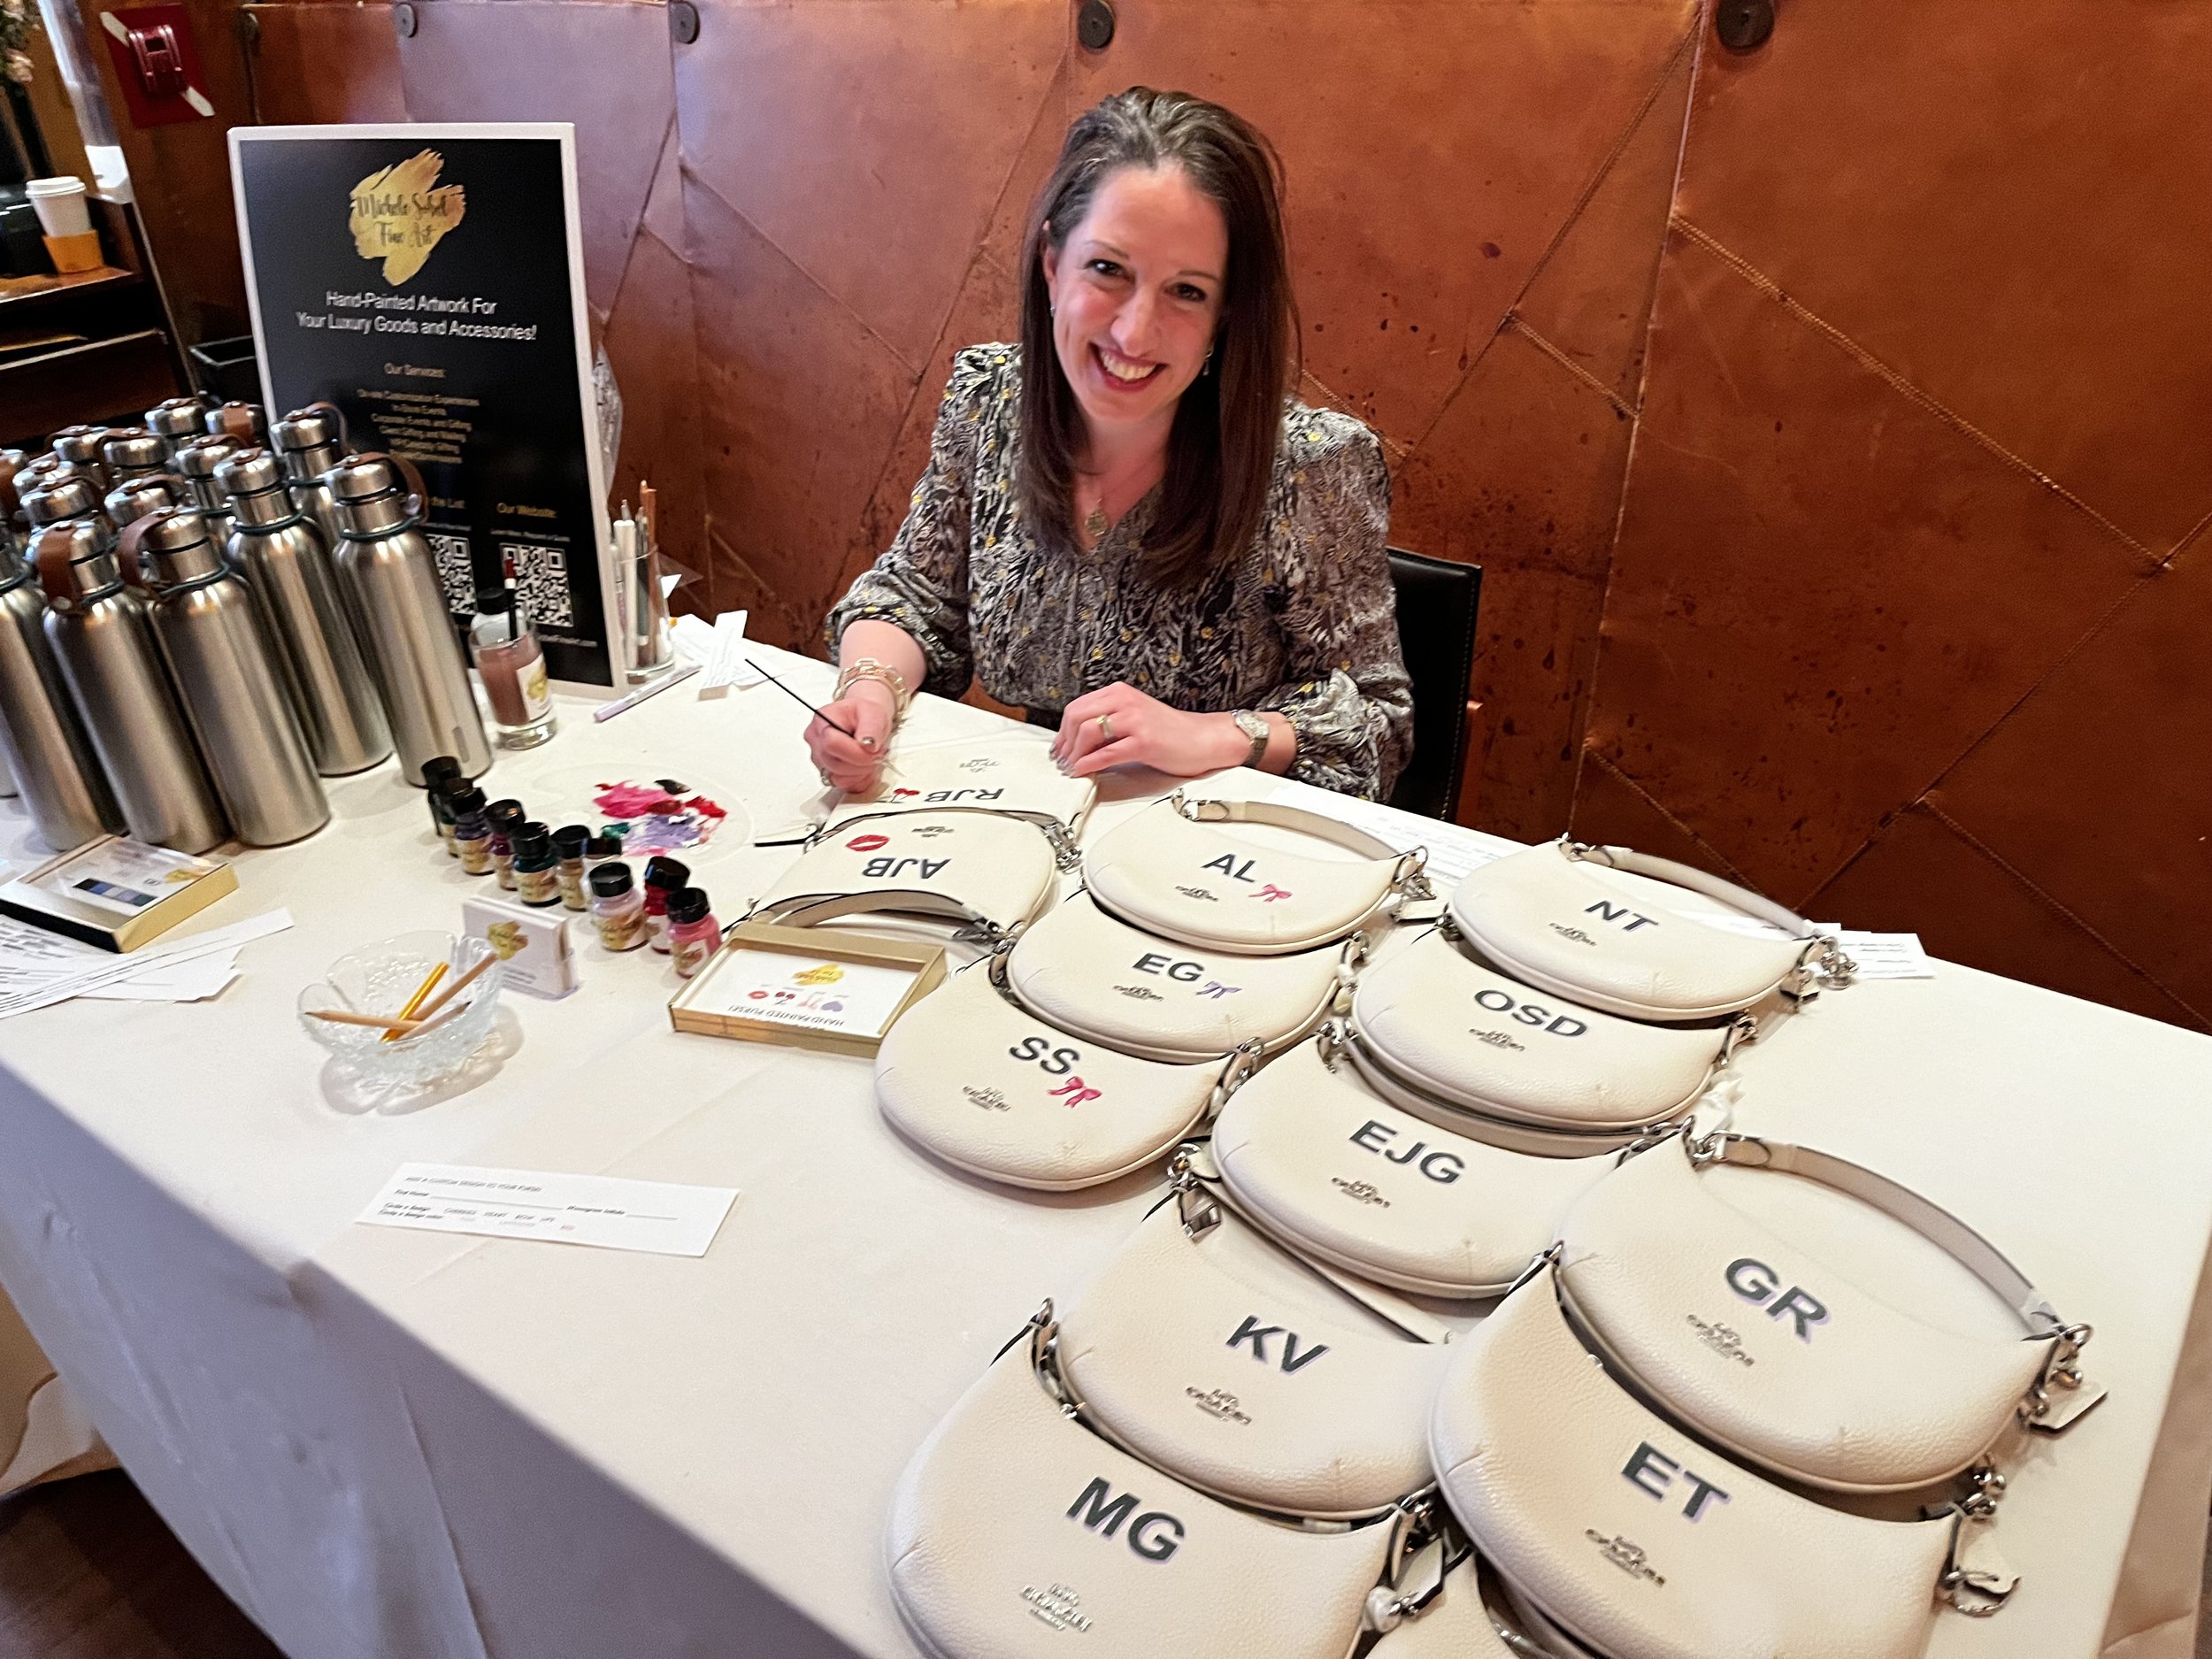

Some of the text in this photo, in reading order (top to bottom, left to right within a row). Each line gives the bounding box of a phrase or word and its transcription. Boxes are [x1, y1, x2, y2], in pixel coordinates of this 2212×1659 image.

[326, 290, 497, 315] Hand-Painted Artwork For
[296, 311, 537, 341] Your Luxury Goods and Accessories!
[924, 787, 1005, 803] RJB
[862, 856, 952, 879] AJB
[1200, 852, 1257, 884] AL
[1584, 899, 1660, 933] NT
[1132, 951, 1206, 982] EG
[1473, 989, 1589, 1037] OSD
[1009, 1036, 1081, 1075] SS
[1348, 1118, 1466, 1185] EJG
[1724, 1257, 1832, 1344] GR
[1225, 1314, 1331, 1375] KV
[1620, 1440, 1732, 1524] ET
[1064, 1475, 1187, 1564] MG
